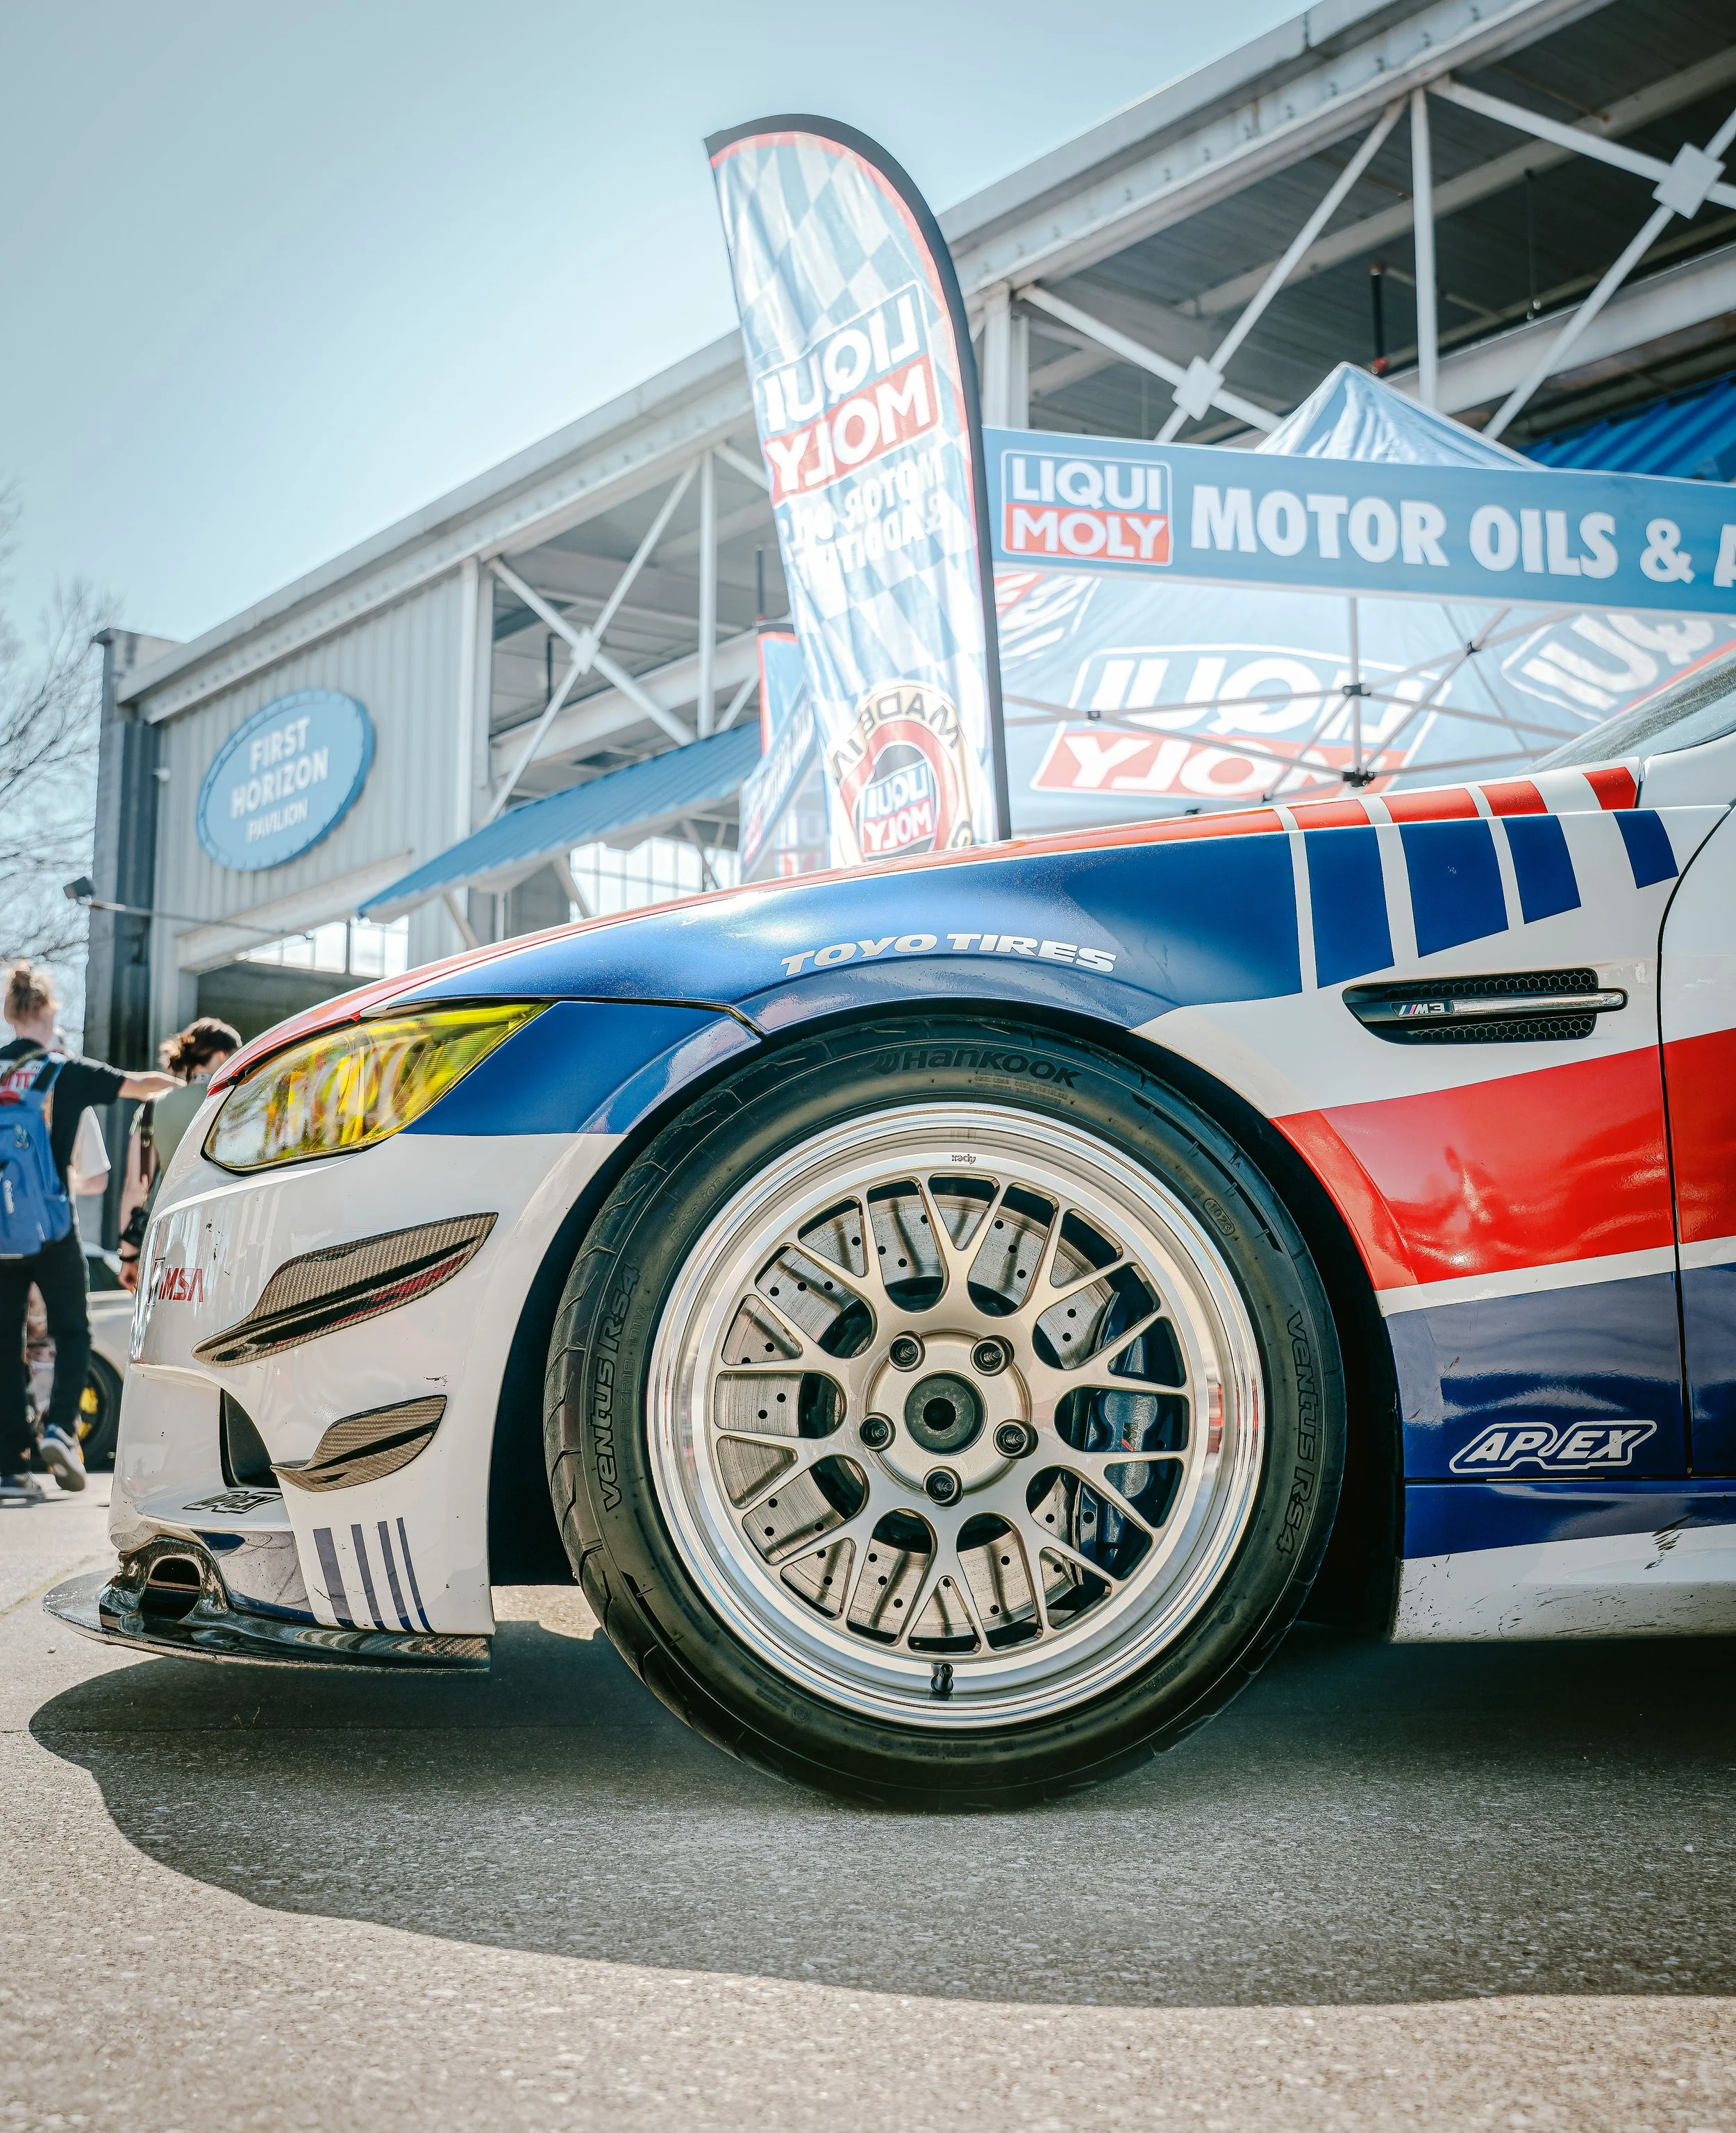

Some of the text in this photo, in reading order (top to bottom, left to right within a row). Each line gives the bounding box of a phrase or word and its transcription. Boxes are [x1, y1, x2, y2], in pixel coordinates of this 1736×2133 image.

[1012, 457, 1162, 511] LIQUI
[1012, 508, 1167, 559] MOLY
[1191, 485, 1450, 567] MOTOR
[1469, 503, 1619, 579] OILS
[1639, 517, 1695, 584] &
[250, 715, 310, 773] FIRST
[230, 746, 328, 819] HORIZON
[247, 798, 308, 844] PAVILION
[781, 933, 1117, 976] TOYO TIRES
[1414, 1003, 1445, 1015] M3
[1208, 1201, 1233, 1232] 1023
[598, 1263, 641, 1355] RS4
[1463, 1430, 1642, 1462] APEX
[1276, 1466, 1316, 1555] RS4
